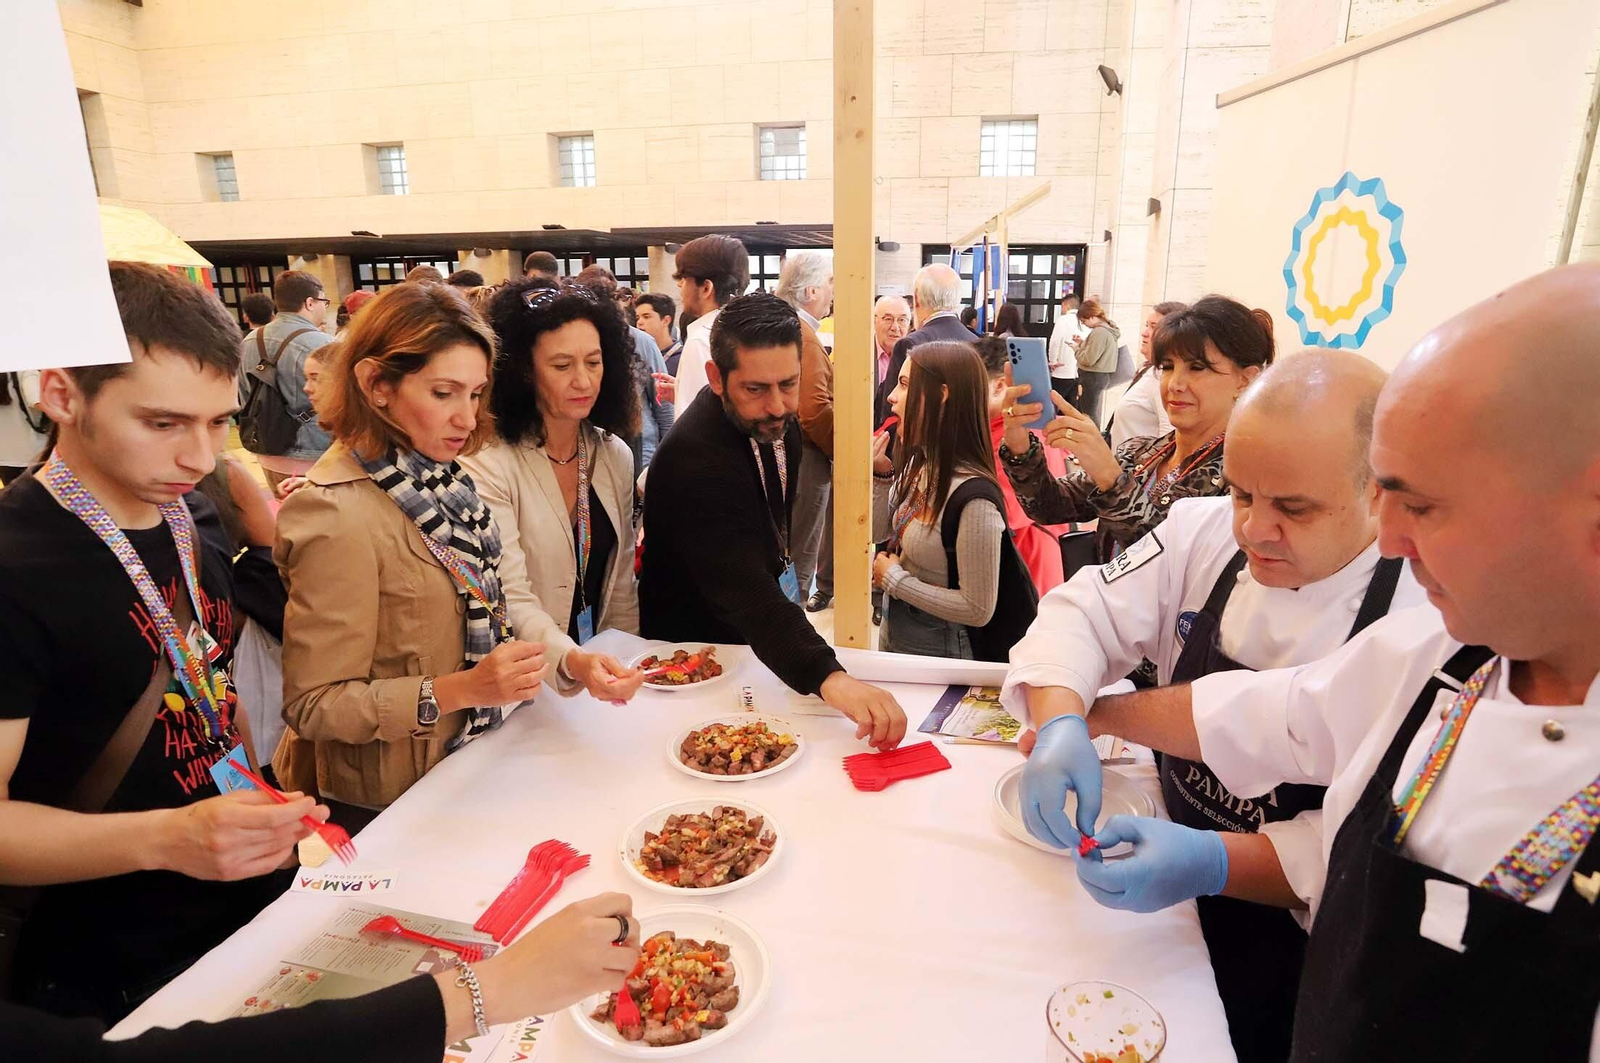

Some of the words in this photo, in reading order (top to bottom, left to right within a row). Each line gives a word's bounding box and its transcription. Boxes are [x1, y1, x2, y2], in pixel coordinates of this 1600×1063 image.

[1185, 765, 1266, 825] PAMPA
[301, 877, 363, 892] PAMPA
[369, 879, 392, 890] LA
